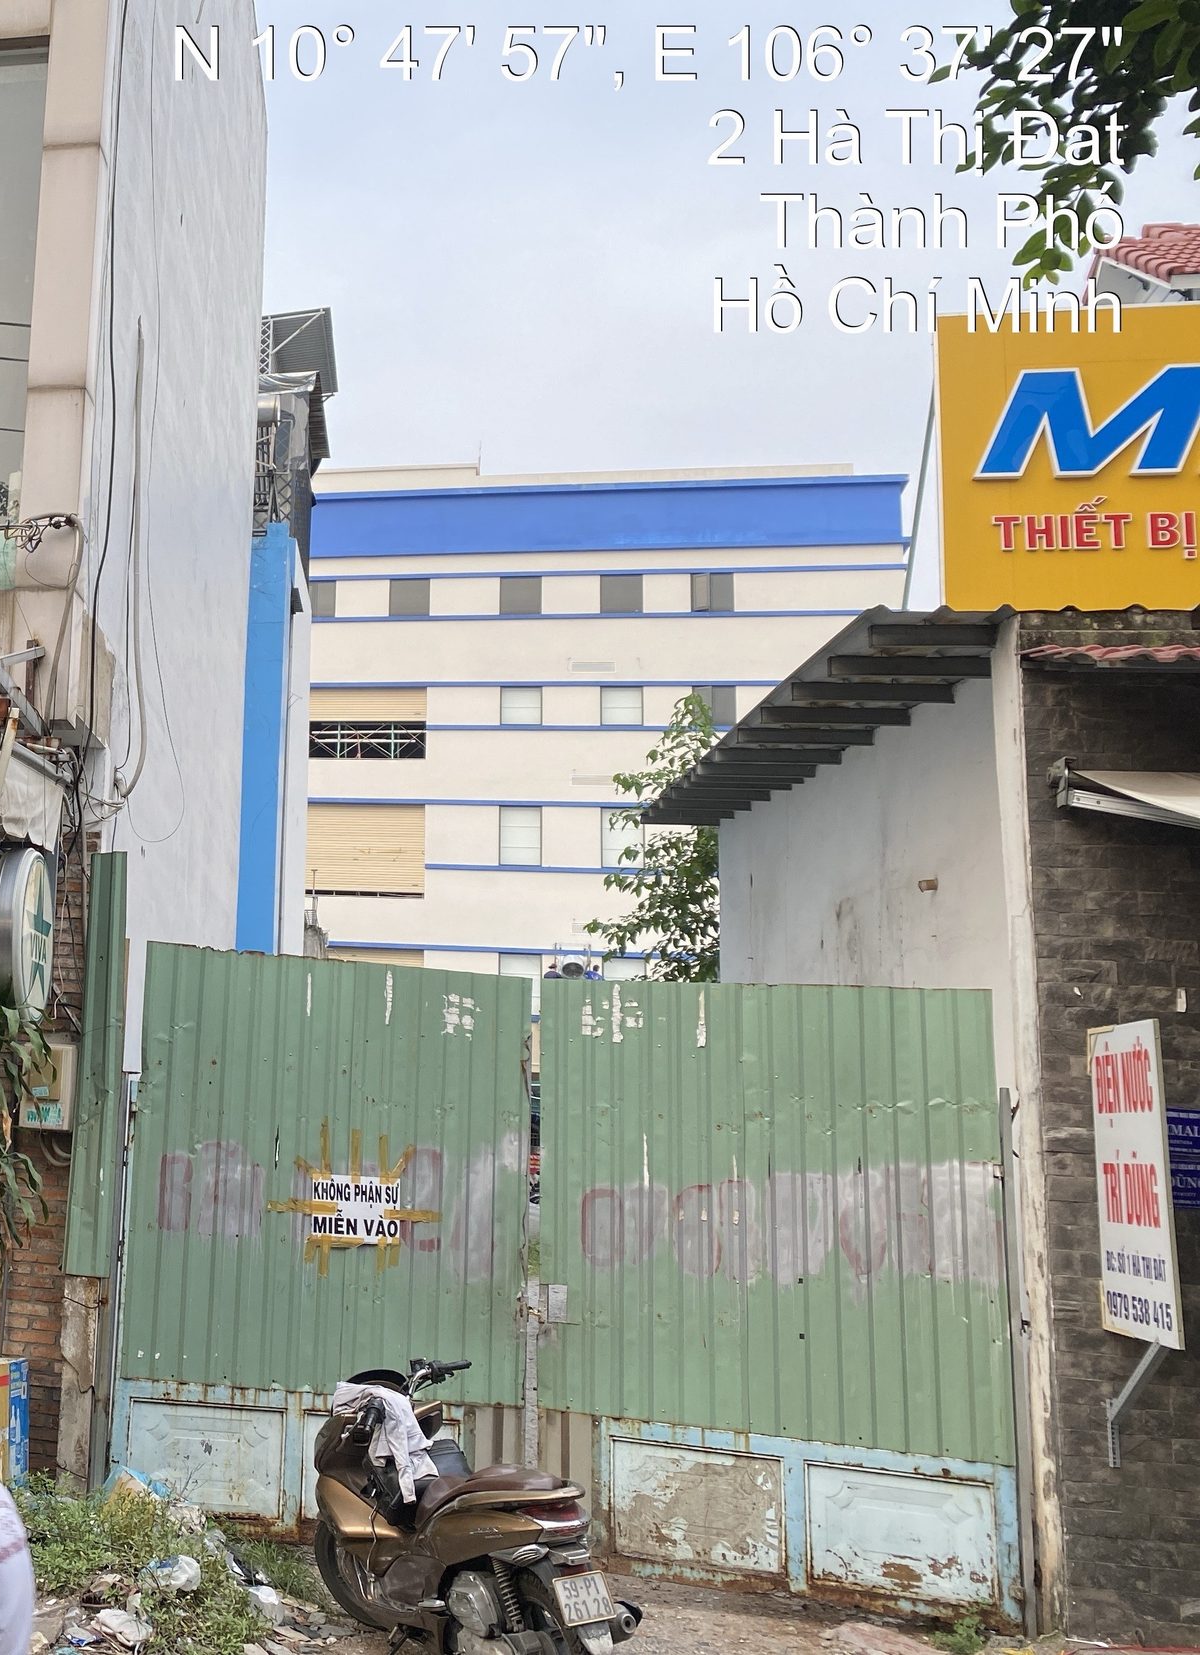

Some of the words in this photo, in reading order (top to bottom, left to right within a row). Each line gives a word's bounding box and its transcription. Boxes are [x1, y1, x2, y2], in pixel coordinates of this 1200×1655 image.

[991, 495, 1133, 551] THIẾT
[1147, 510, 1198, 560] BỊ
[30, 931, 47, 964] VIVA
[1095, 1040, 1121, 1129] ĐIỆN
[1121, 1035, 1154, 1113] NƯỚC
[313, 1178, 351, 1202] KHÔNG
[354, 1180, 382, 1209] PHẬN
[385, 1183, 400, 1210] SỰ
[313, 1208, 358, 1236] MIỄN
[363, 1214, 399, 1238] VÀO
[1106, 1289, 1130, 1321] 0979
[1131, 1295, 1151, 1327] 538
[1153, 1300, 1173, 1332] 415
[561, 1575, 600, 1600] 59-P1
